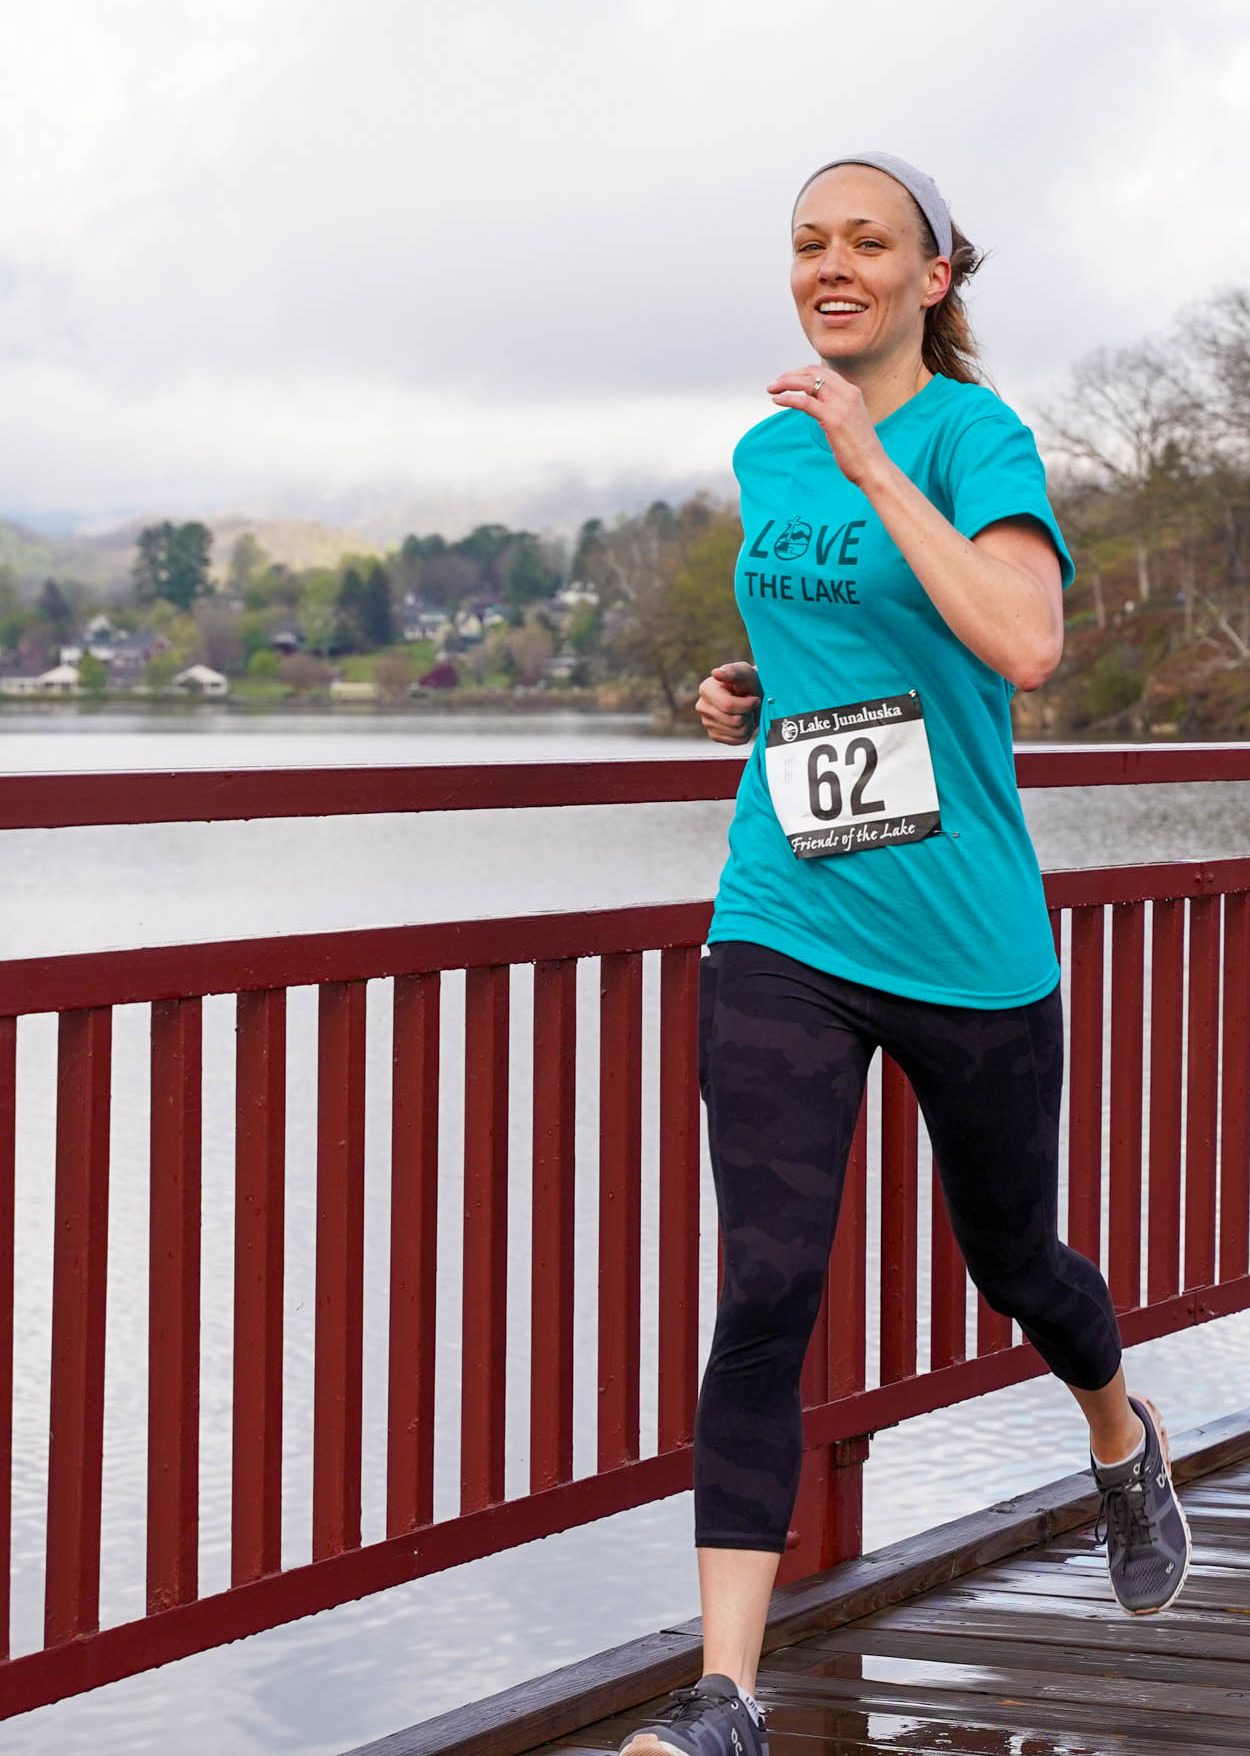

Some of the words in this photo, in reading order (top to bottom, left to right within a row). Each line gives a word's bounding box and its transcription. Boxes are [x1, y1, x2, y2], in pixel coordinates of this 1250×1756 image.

[749, 517, 867, 566] LOVE
[744, 571, 794, 600] THE
[801, 577, 861, 605] LAKE
[798, 717, 831, 734] Lake
[832, 703, 903, 731] Junaluska
[807, 737, 886, 821] 62
[791, 830, 838, 853] Friends
[841, 827, 855, 851] of
[857, 824, 877, 842] the
[880, 818, 916, 839] Lake
